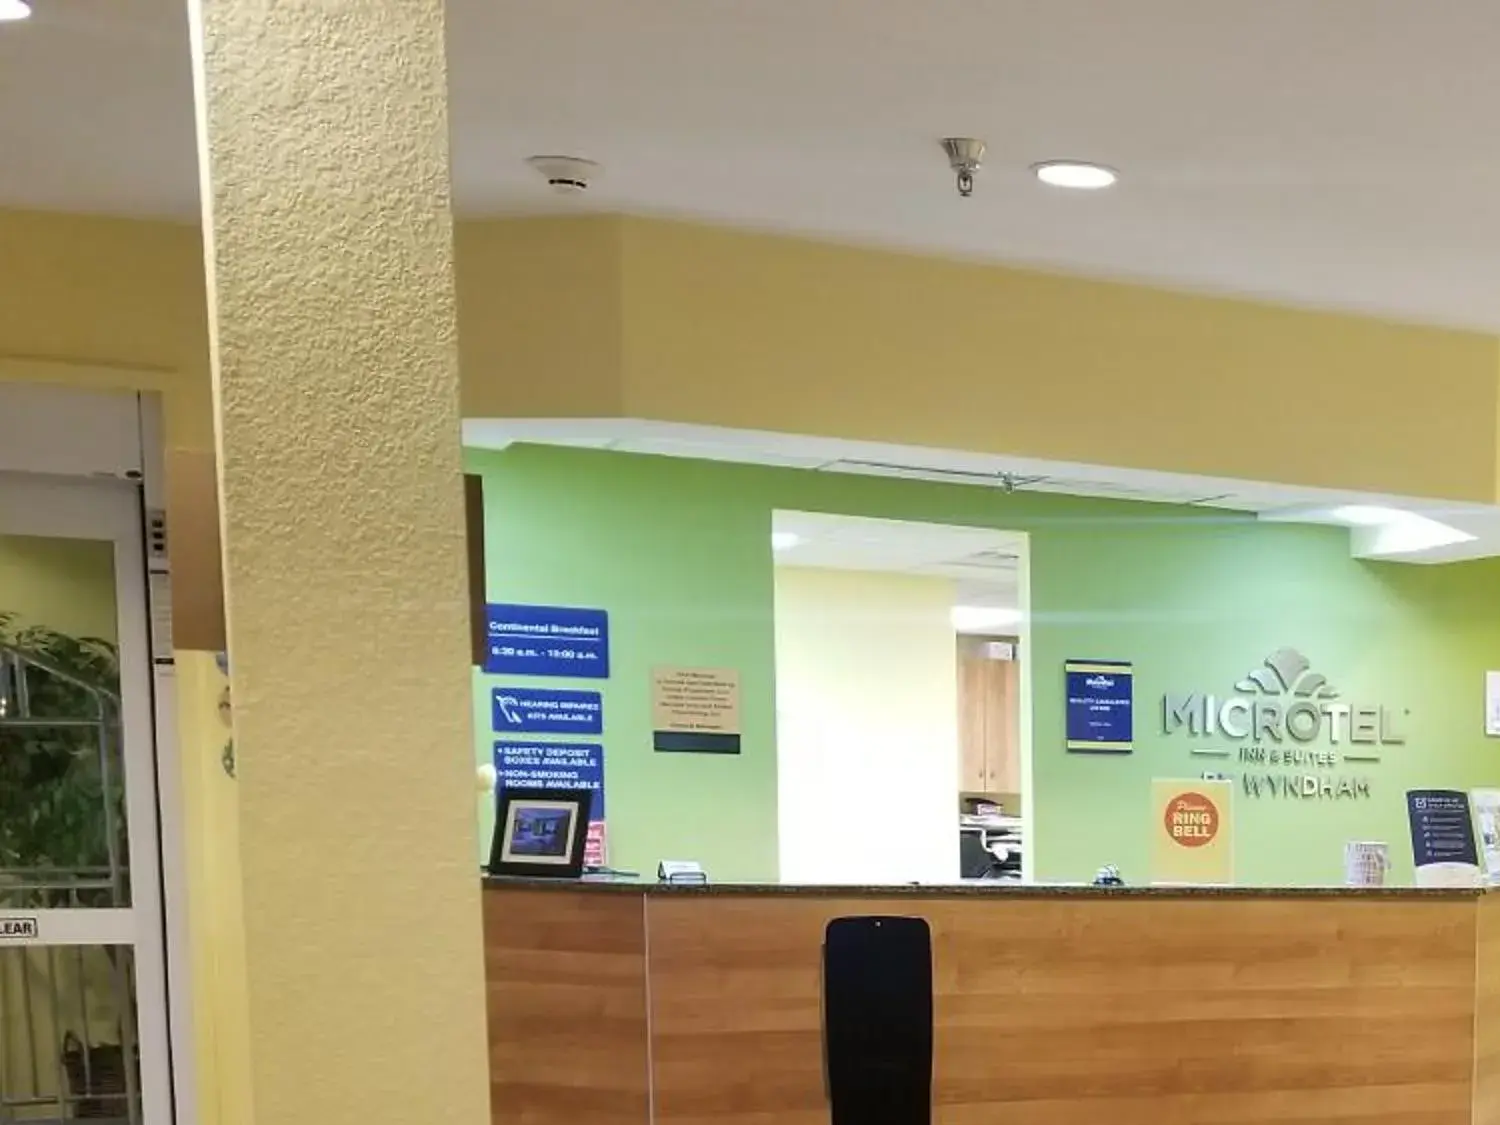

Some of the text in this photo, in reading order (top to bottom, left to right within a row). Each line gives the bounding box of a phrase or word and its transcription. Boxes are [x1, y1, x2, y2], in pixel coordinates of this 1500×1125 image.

[489, 621, 600, 636] Continental Breakfast
[1161, 692, 1406, 745] MICROTEL
[503, 746, 590, 757] SAFETY DEPOSIT
[1238, 747, 1266, 763] INN
[1284, 750, 1337, 767] SUITES
[503, 756, 597, 767] BOXES AVAILABLE
[504, 769, 579, 780] NON-SMOKING
[505, 779, 600, 790] ROOMS AVAILABLE
[1242, 771, 1371, 800] WYNDHAM
[1172, 811, 1212, 826] RING
[1172, 824, 1212, 838] BELL
